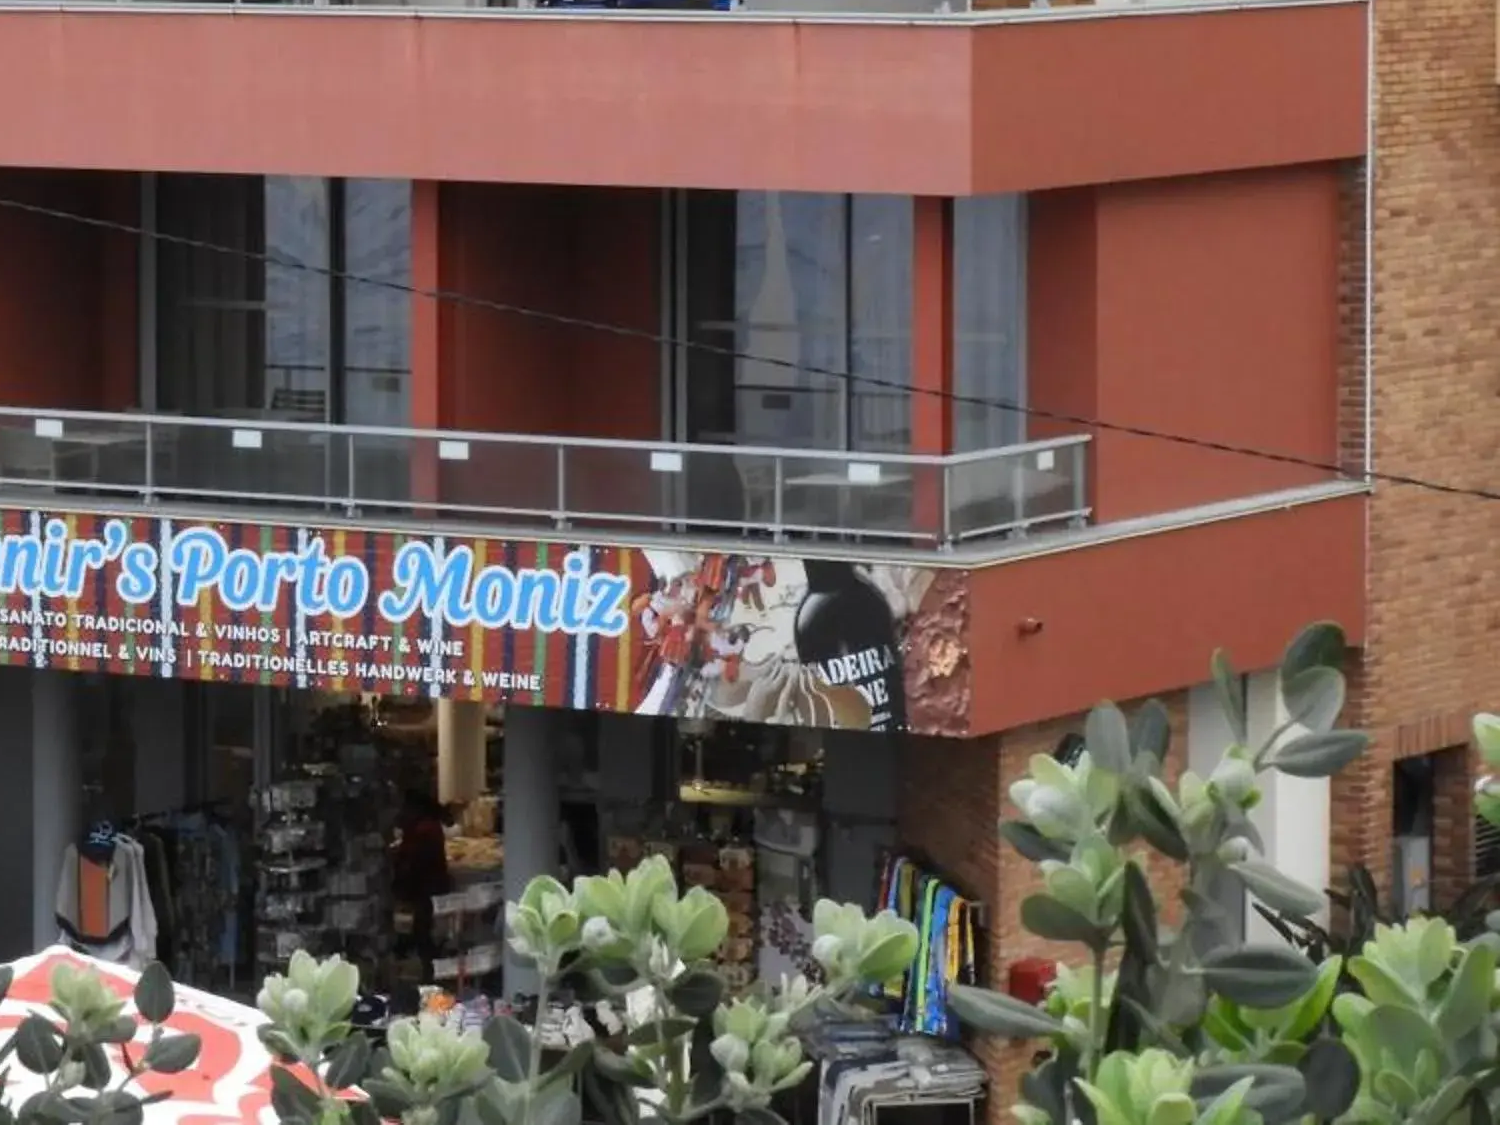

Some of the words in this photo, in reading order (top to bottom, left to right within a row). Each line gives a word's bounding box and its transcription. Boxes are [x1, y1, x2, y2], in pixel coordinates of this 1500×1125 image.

[170, 526, 368, 617] Porto
[378, 540, 630, 637] Moniz
[76, 613, 189, 637] TRADICIONAL
[196, 623, 211, 637] &
[215, 624, 280, 643] VINHOS
[297, 631, 392, 652] ARTCRAFT
[399, 637, 411, 653] &
[416, 638, 464, 656] WINE
[118, 645, 130, 660] &
[135, 645, 177, 663] VINS
[197, 650, 349, 676] TRADITIONELLES
[355, 664, 456, 685] HANDWERK
[463, 669, 475, 685] &
[481, 672, 541, 692] WEINE
[802, 644, 896, 687] ADEIRA
